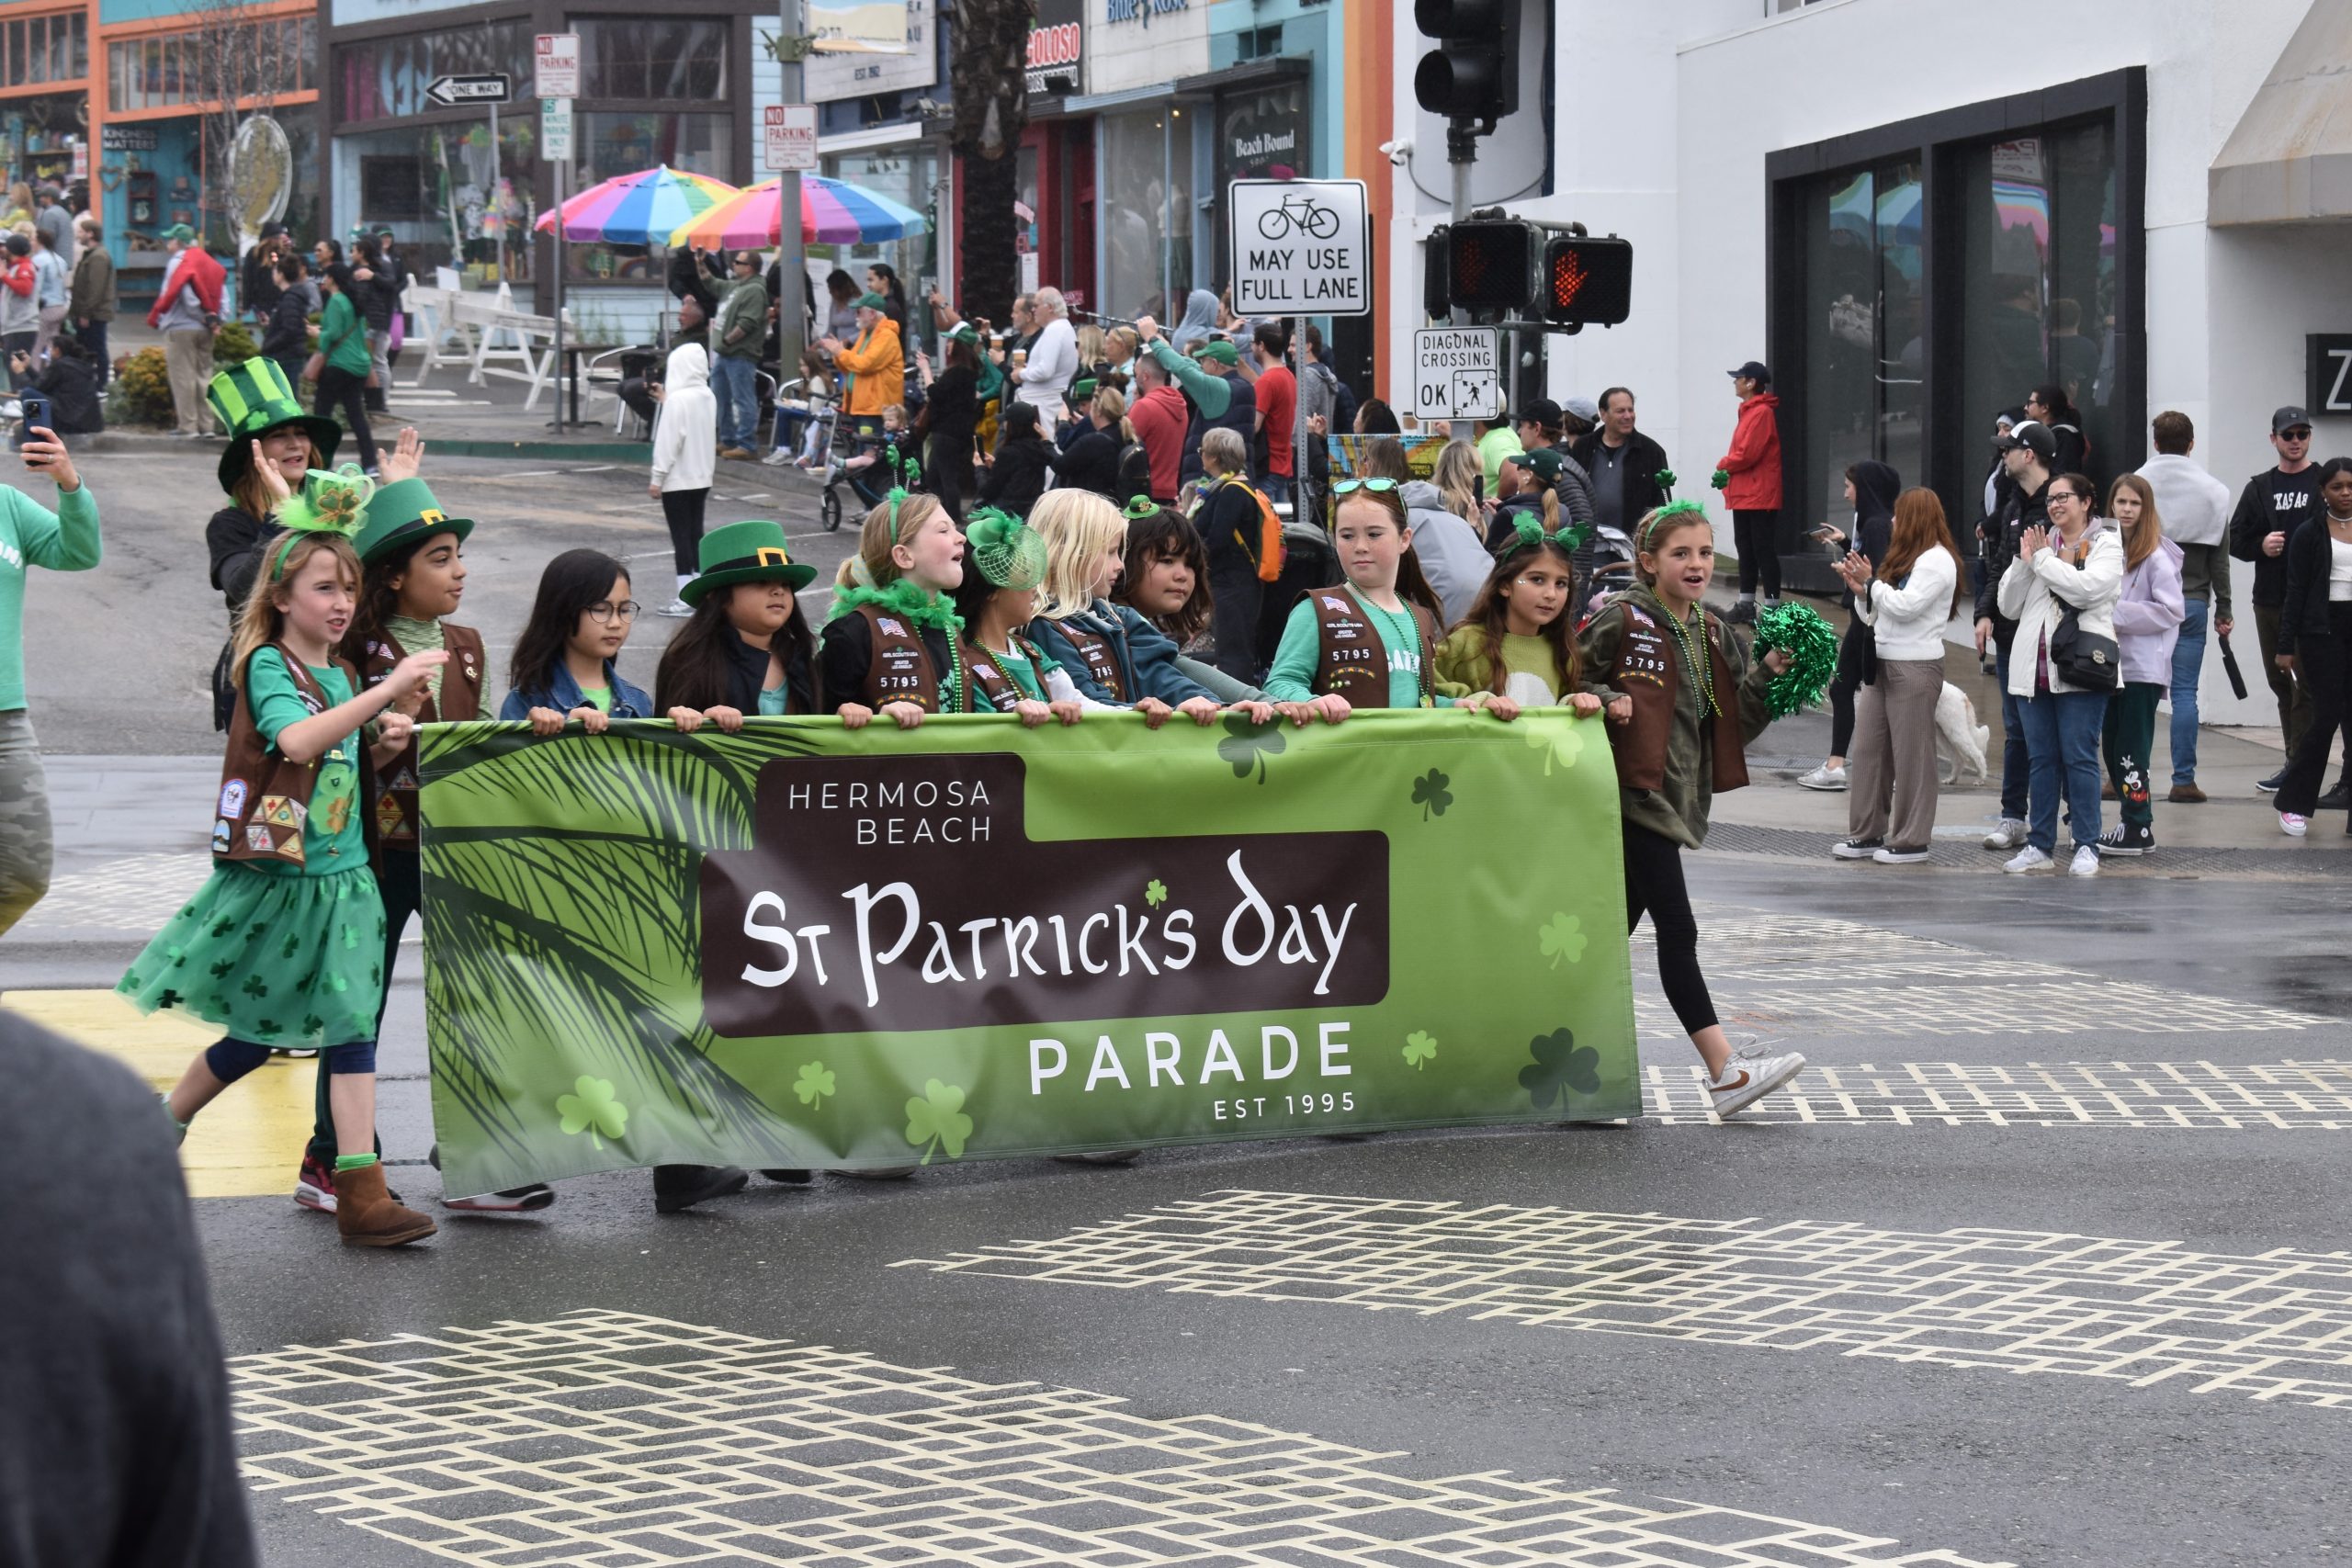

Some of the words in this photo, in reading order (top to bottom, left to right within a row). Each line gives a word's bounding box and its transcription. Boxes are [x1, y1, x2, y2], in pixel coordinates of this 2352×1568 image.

[537, 37, 551, 54] NO
[540, 57, 574, 70] PARKING
[451, 85, 473, 96] ONE
[477, 83, 500, 93] WAY
[766, 108, 783, 124] NO
[769, 127, 812, 141] PARKING
[104, 140, 156, 149] MATTERS
[1236, 135, 1262, 158] Beach
[1264, 129, 1295, 152] Bound
[1250, 249, 1294, 271] MAY
[1307, 248, 1350, 270] USE
[1242, 278, 1293, 300] FULL
[1304, 277, 1358, 299] LANE
[1423, 333, 1488, 350] DIAGONAL
[1421, 352, 1490, 367] CROSSING
[1421, 384, 1447, 406] OK
[2273, 491, 2294, 511] XAS
[1332, 649, 1370, 661] 5795
[1625, 656, 1665, 671] 5795
[1089, 665, 1113, 679] 795
[880, 675, 918, 688] 5795
[789, 780, 989, 809] HERMOSA
[856, 816, 990, 845] BEACH
[1029, 1021, 1351, 1095] PARADE
[1214, 1098, 1266, 1120] EST
[1285, 1091, 1354, 1115] 1995
